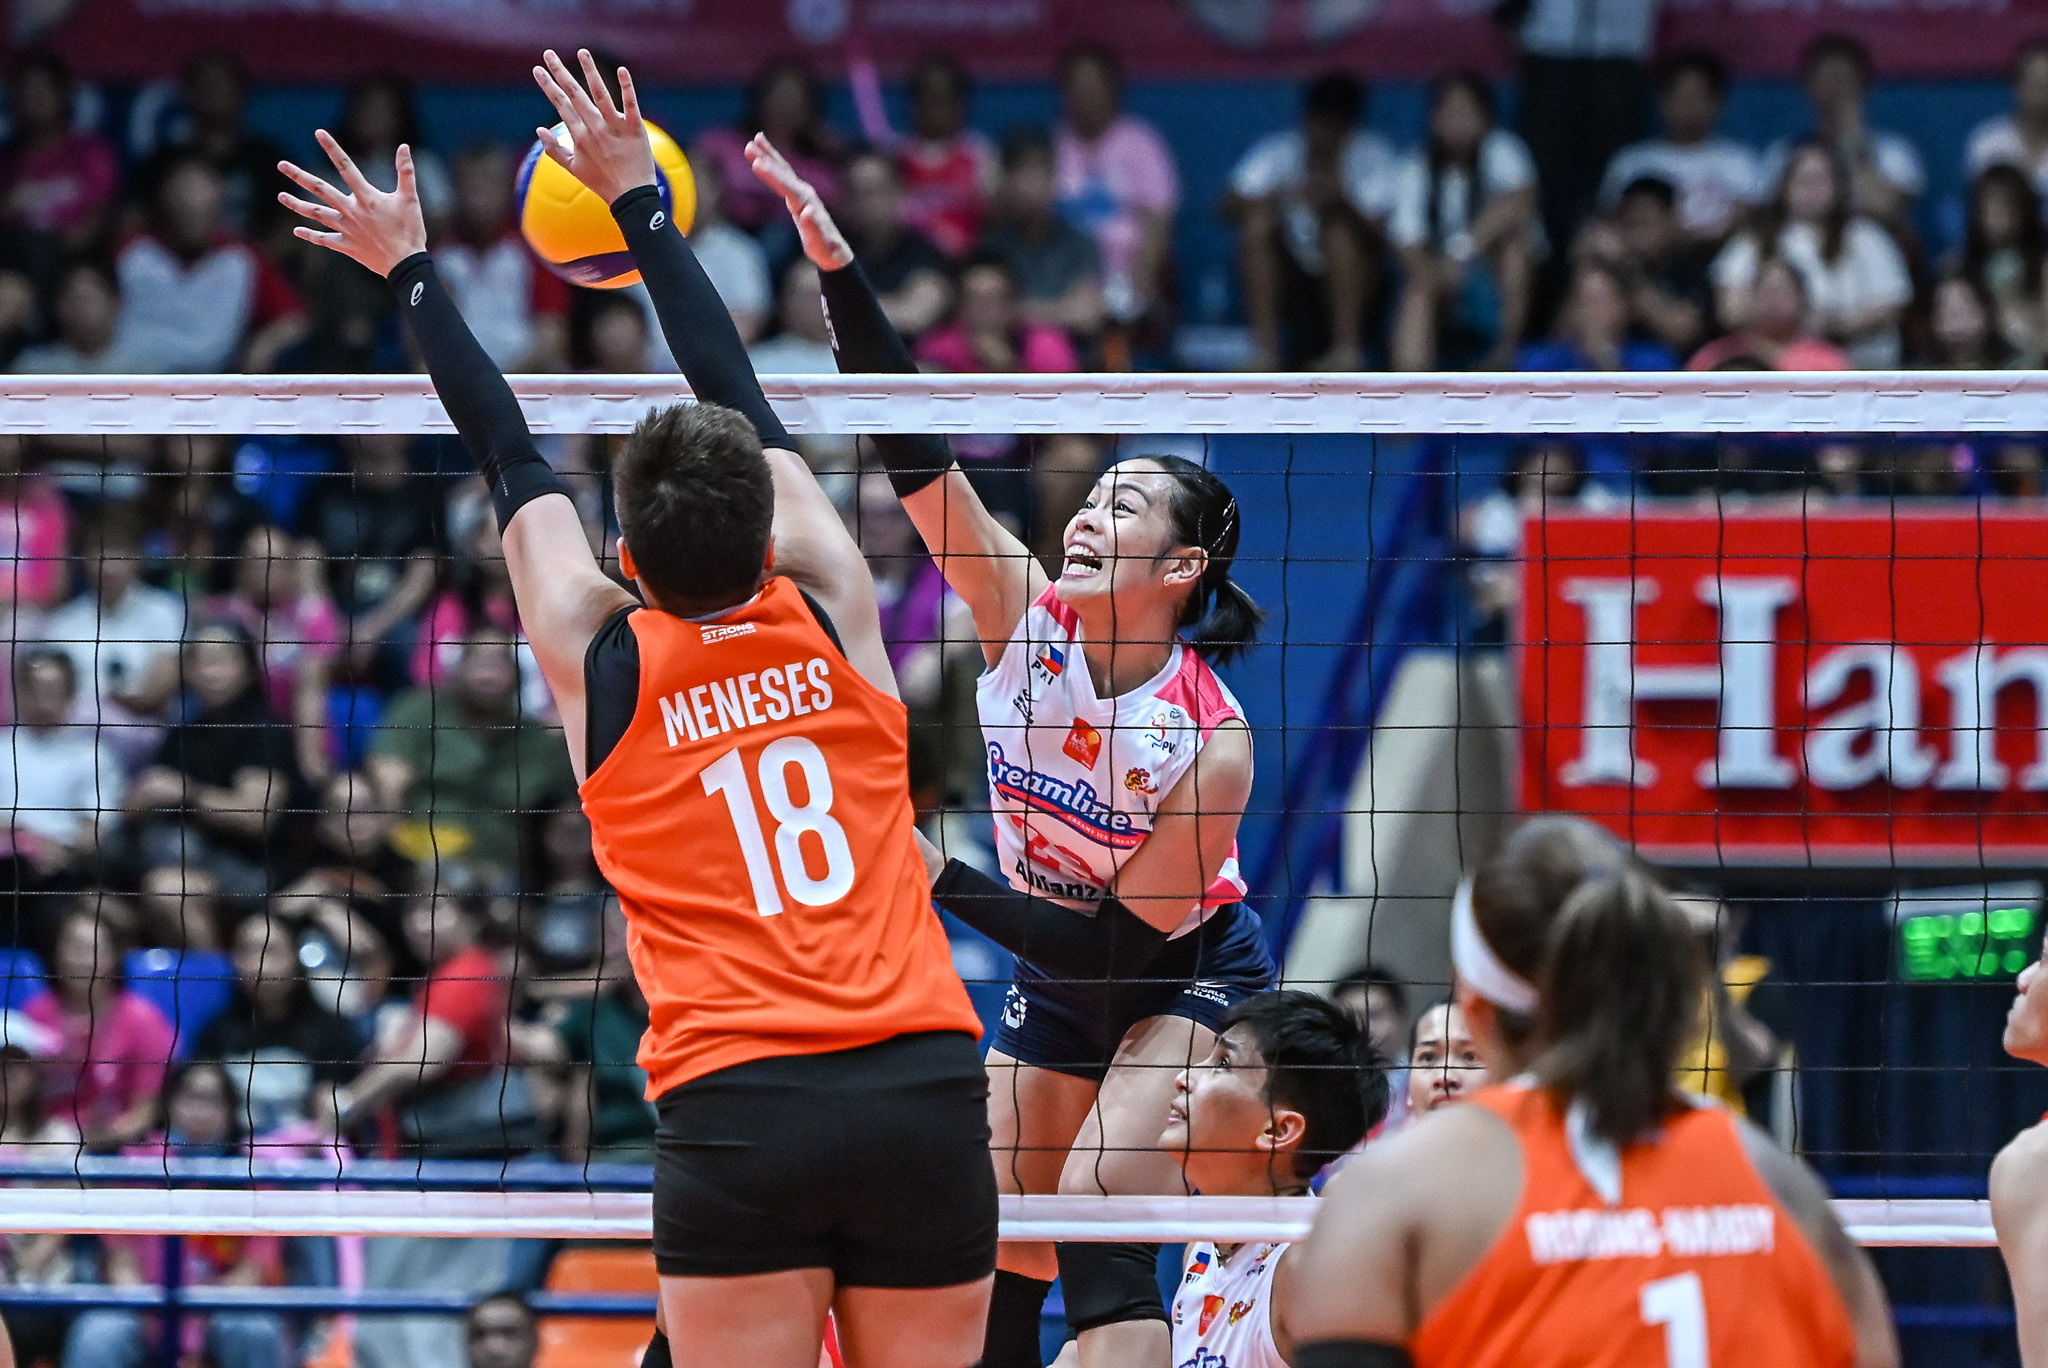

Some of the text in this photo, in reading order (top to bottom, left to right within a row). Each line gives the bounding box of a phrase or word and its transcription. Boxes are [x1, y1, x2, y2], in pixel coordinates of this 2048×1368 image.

[701, 622, 755, 640] STRONG
[658, 657, 833, 747] MENESES
[1559, 575, 2048, 790] Han
[699, 735, 855, 917] 18
[987, 741, 1134, 833] Creamline
[1183, 989, 1230, 1007] BALANCE
[1639, 1270, 1710, 1368] 1
